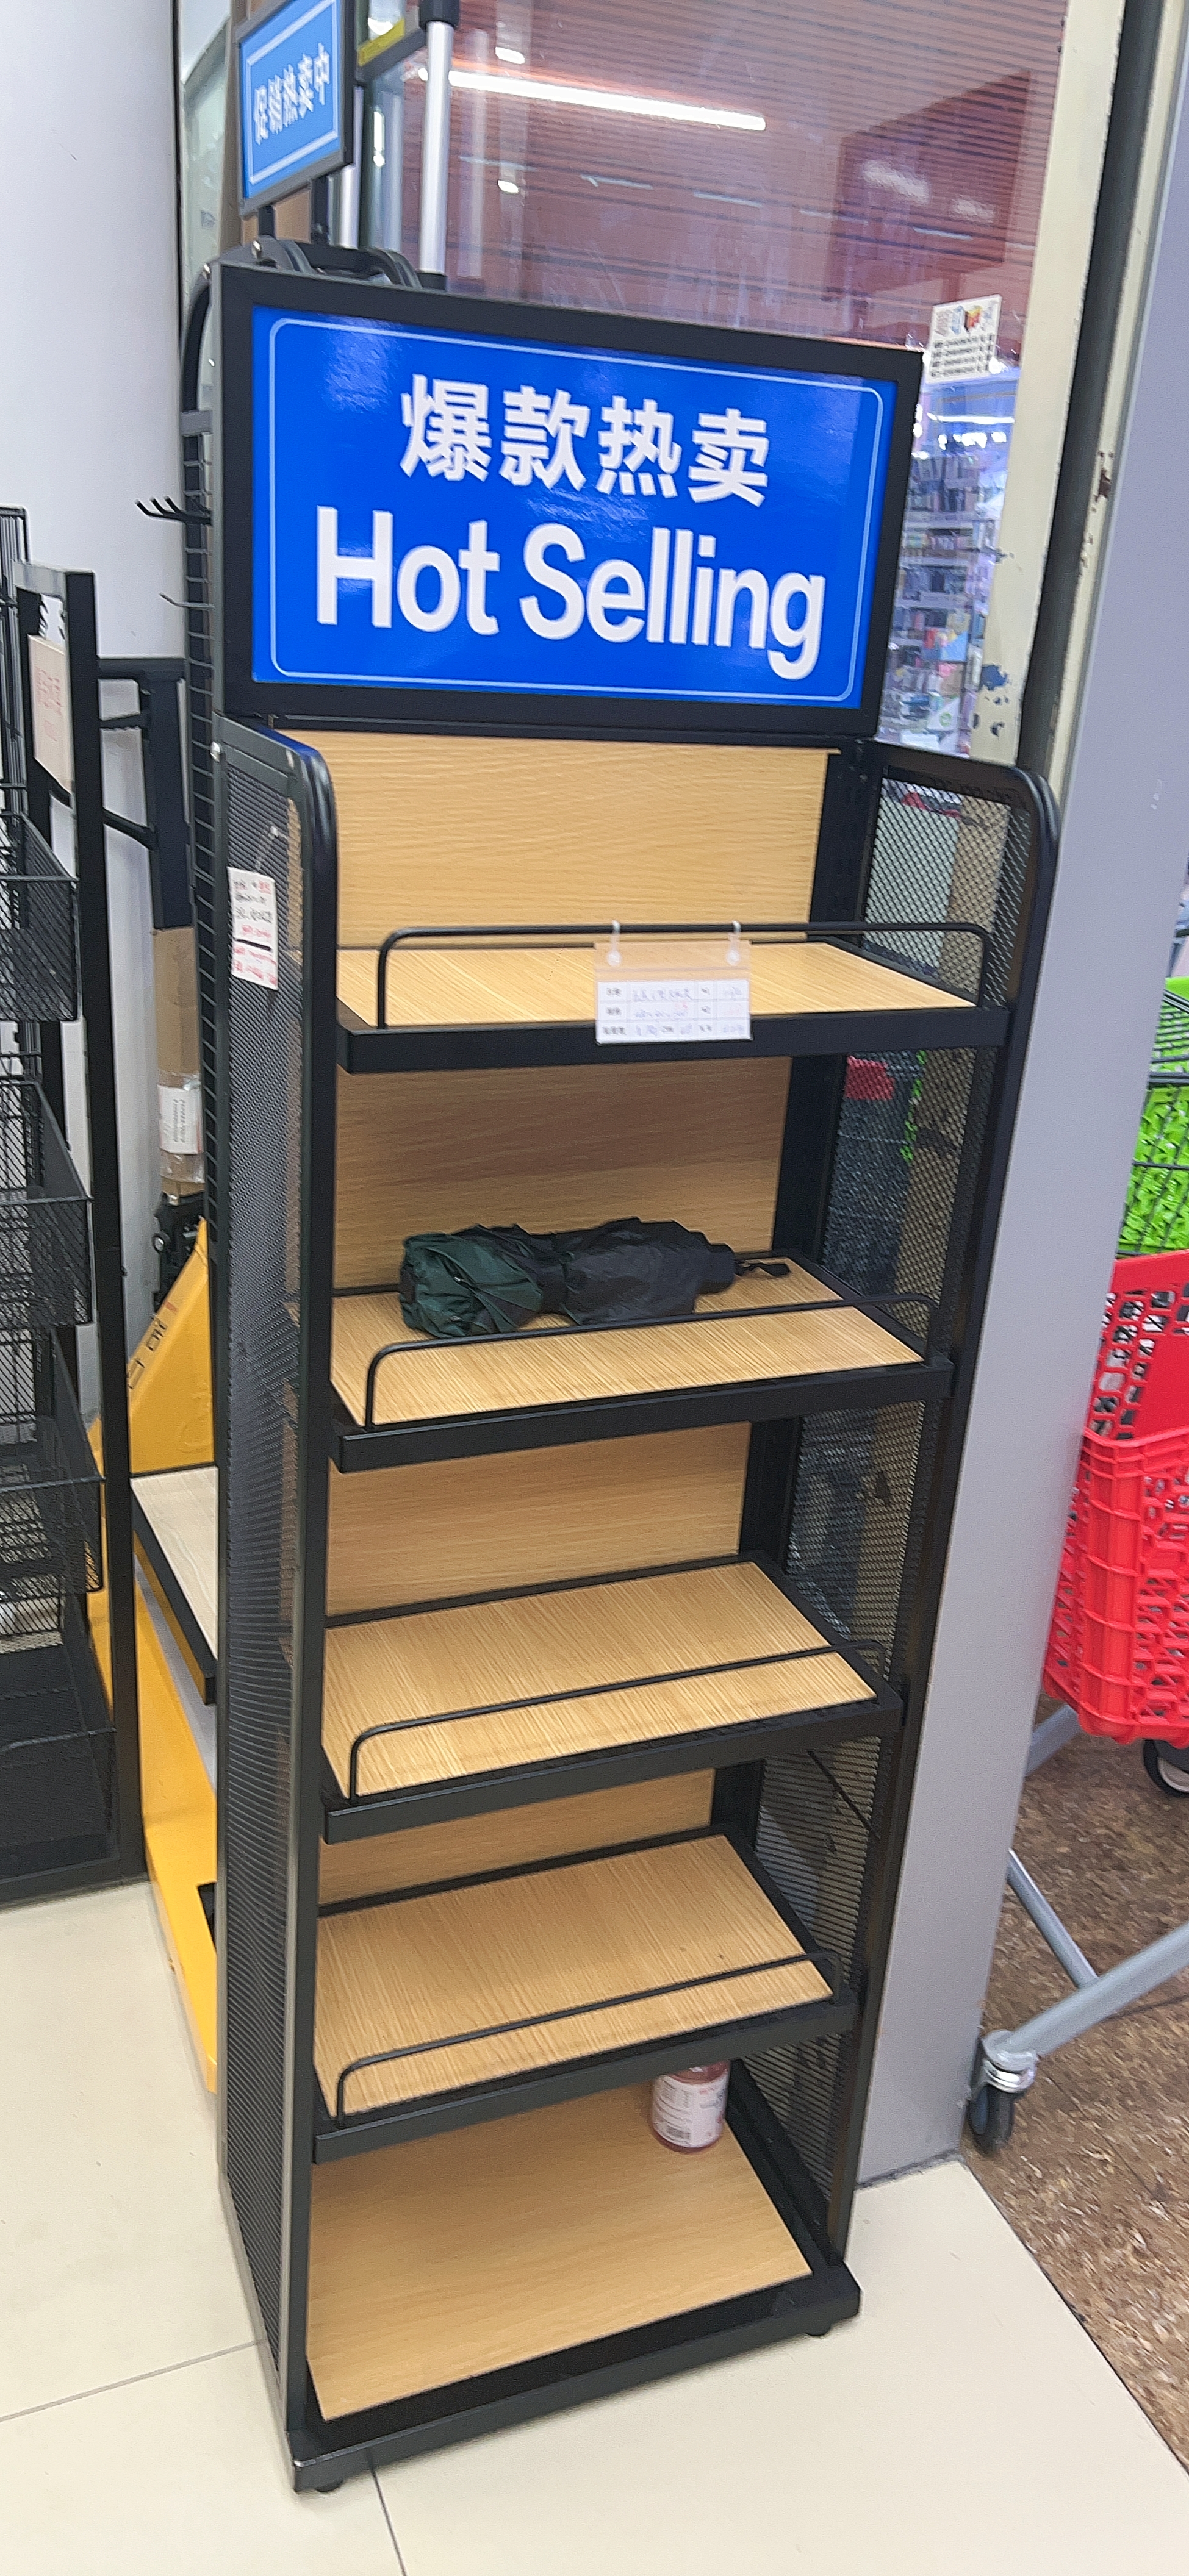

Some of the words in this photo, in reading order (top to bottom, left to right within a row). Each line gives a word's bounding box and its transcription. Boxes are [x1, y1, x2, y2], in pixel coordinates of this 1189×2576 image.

[254, 42, 330, 145] 促销热卖中
[401, 374, 770, 507] 爆款热卖
[317, 506, 500, 635] Hot
[519, 523, 825, 680] Selling
